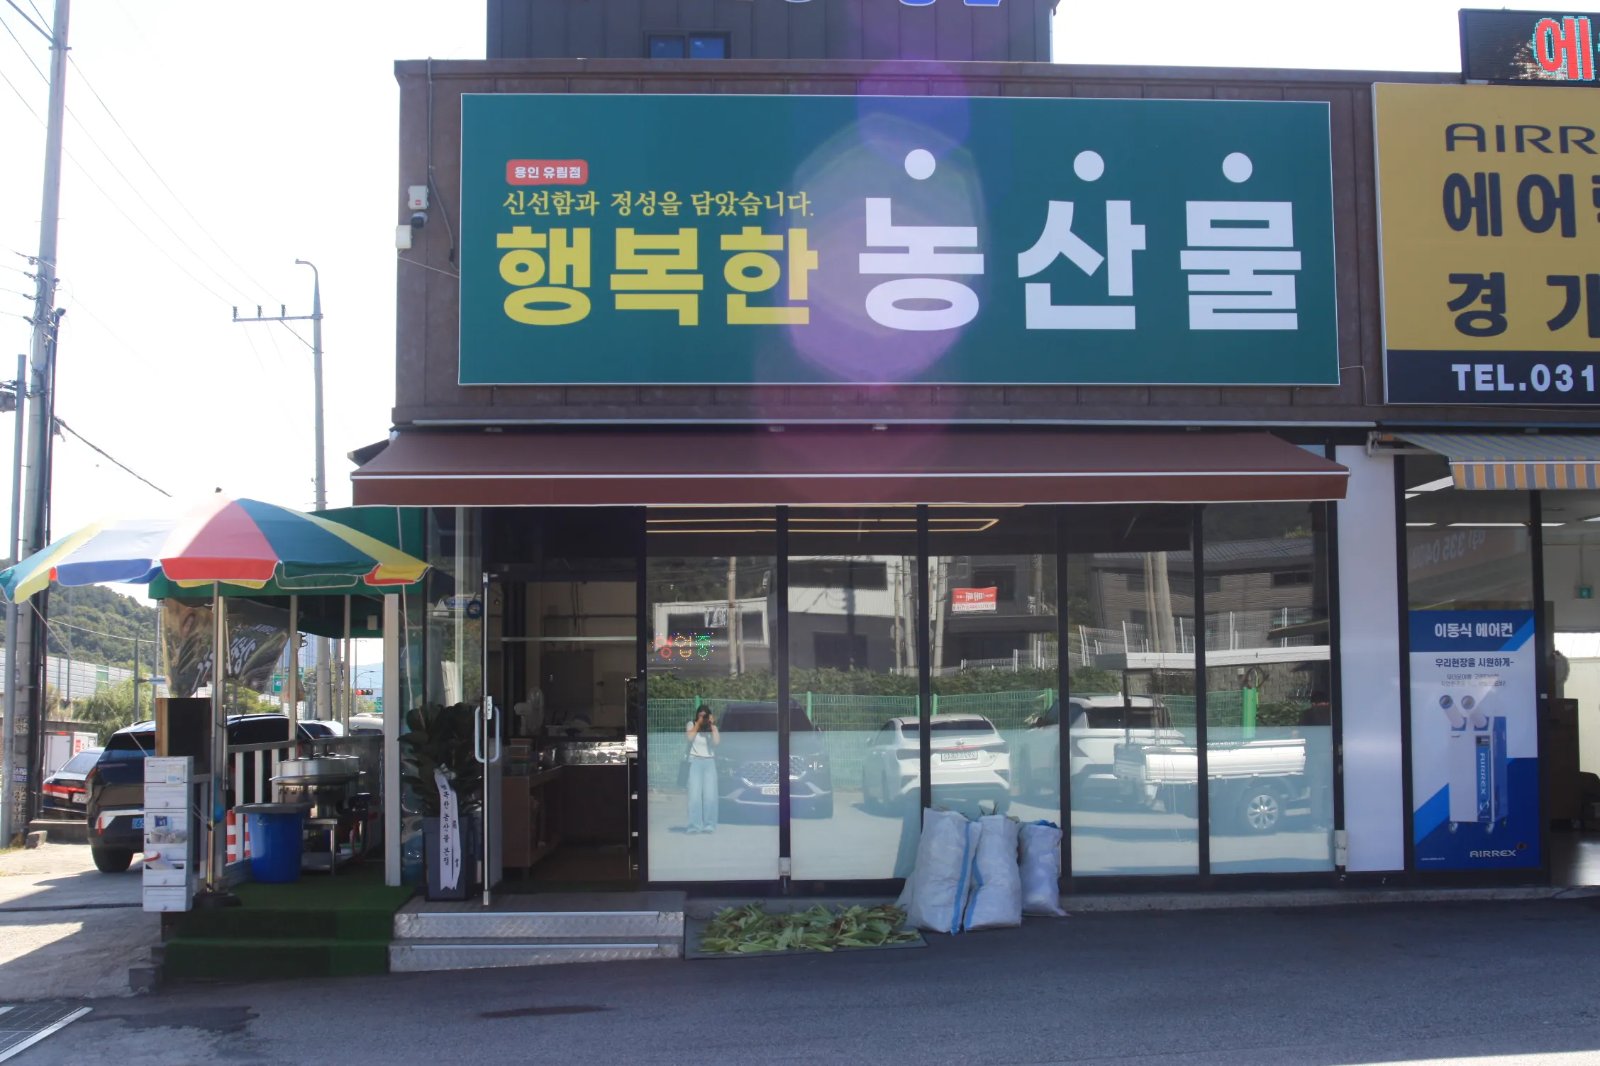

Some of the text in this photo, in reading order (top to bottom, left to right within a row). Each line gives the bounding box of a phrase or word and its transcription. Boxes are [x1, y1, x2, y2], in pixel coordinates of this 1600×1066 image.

[514, 166, 582, 179] 용인 유림점
[503, 190, 815, 217] 신선함과 정성을 담았습니다.
[1442, 171, 1600, 239] 에어
[495, 196, 1303, 332] 행복한 농산물
[1434, 622, 1514, 638] 이동식 에어컨
[655, 635, 711, 657] 영업중
[1435, 657, 1476, 668] 우리현장을
[1469, 849, 1517, 858] AIRREX
